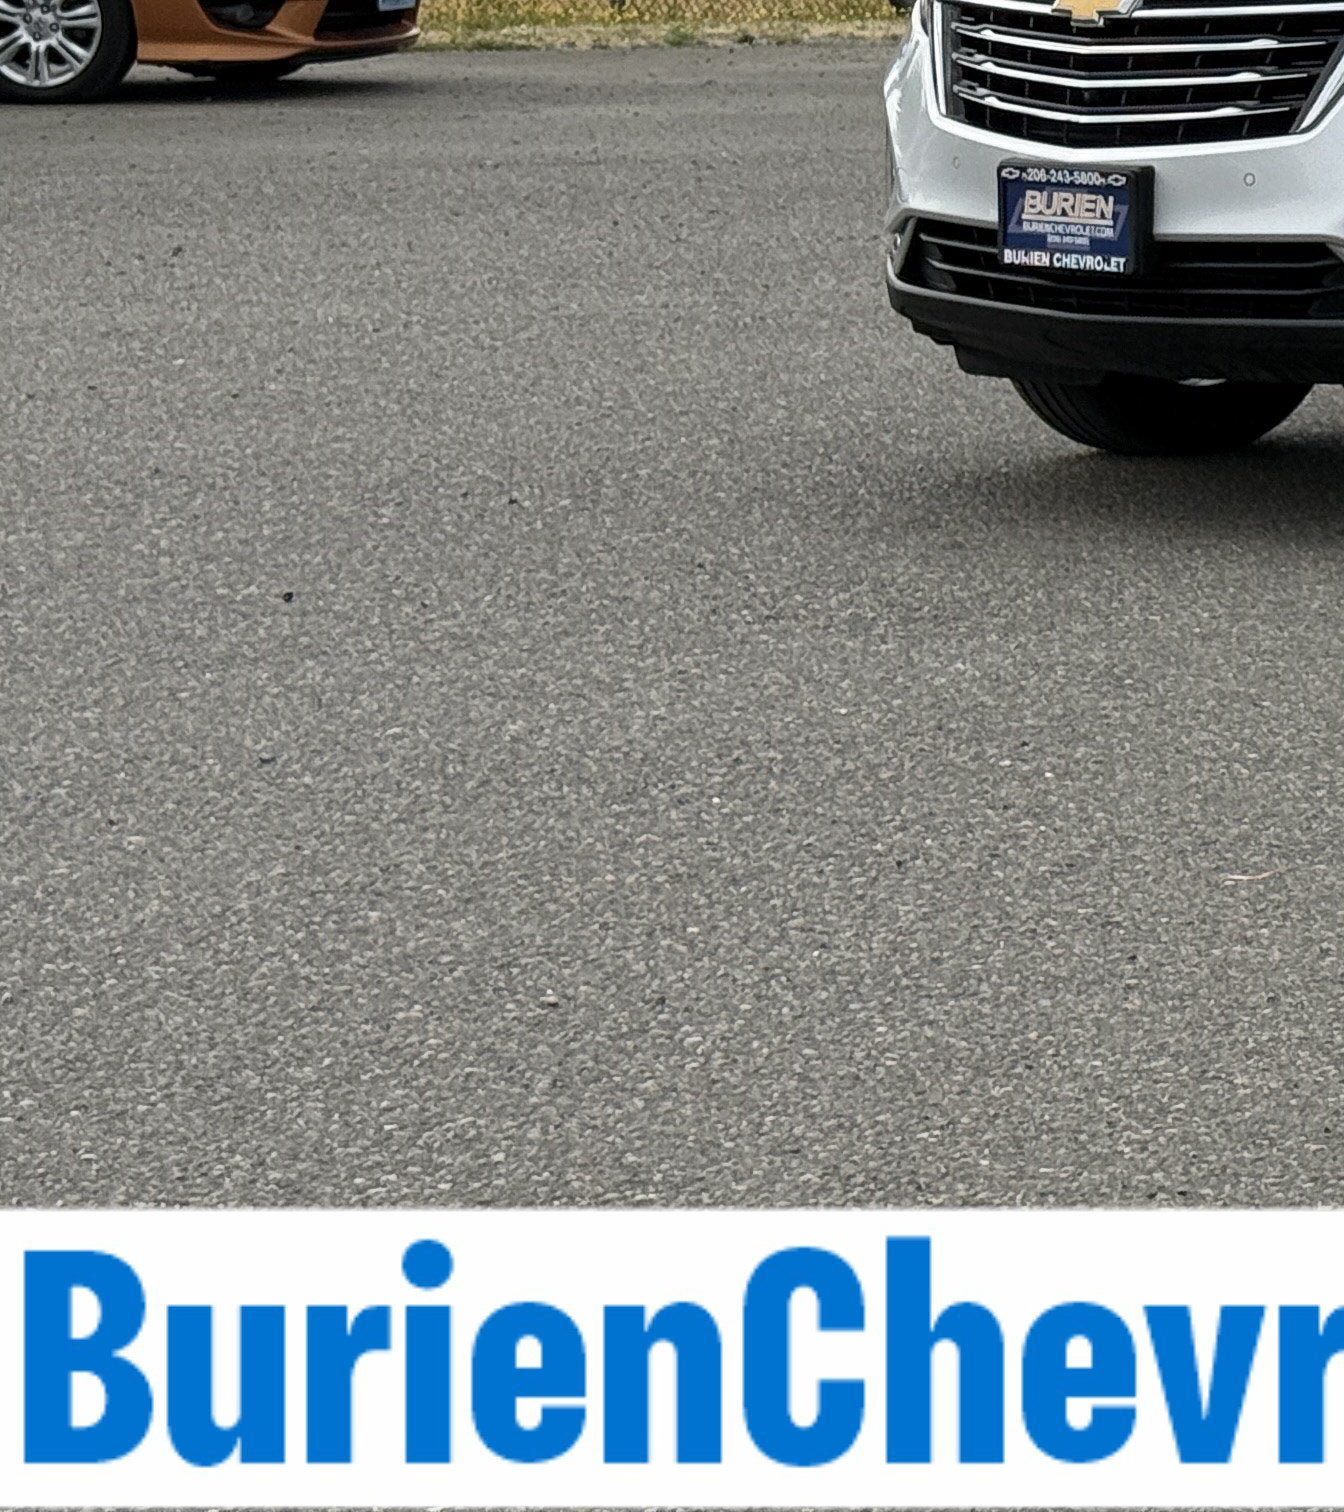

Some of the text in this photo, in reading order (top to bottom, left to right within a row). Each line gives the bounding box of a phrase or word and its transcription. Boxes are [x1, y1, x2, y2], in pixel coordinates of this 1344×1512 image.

[1024, 189, 1114, 219] BURIEN
[1003, 248, 1127, 273] BURIEN CHEVROLET
